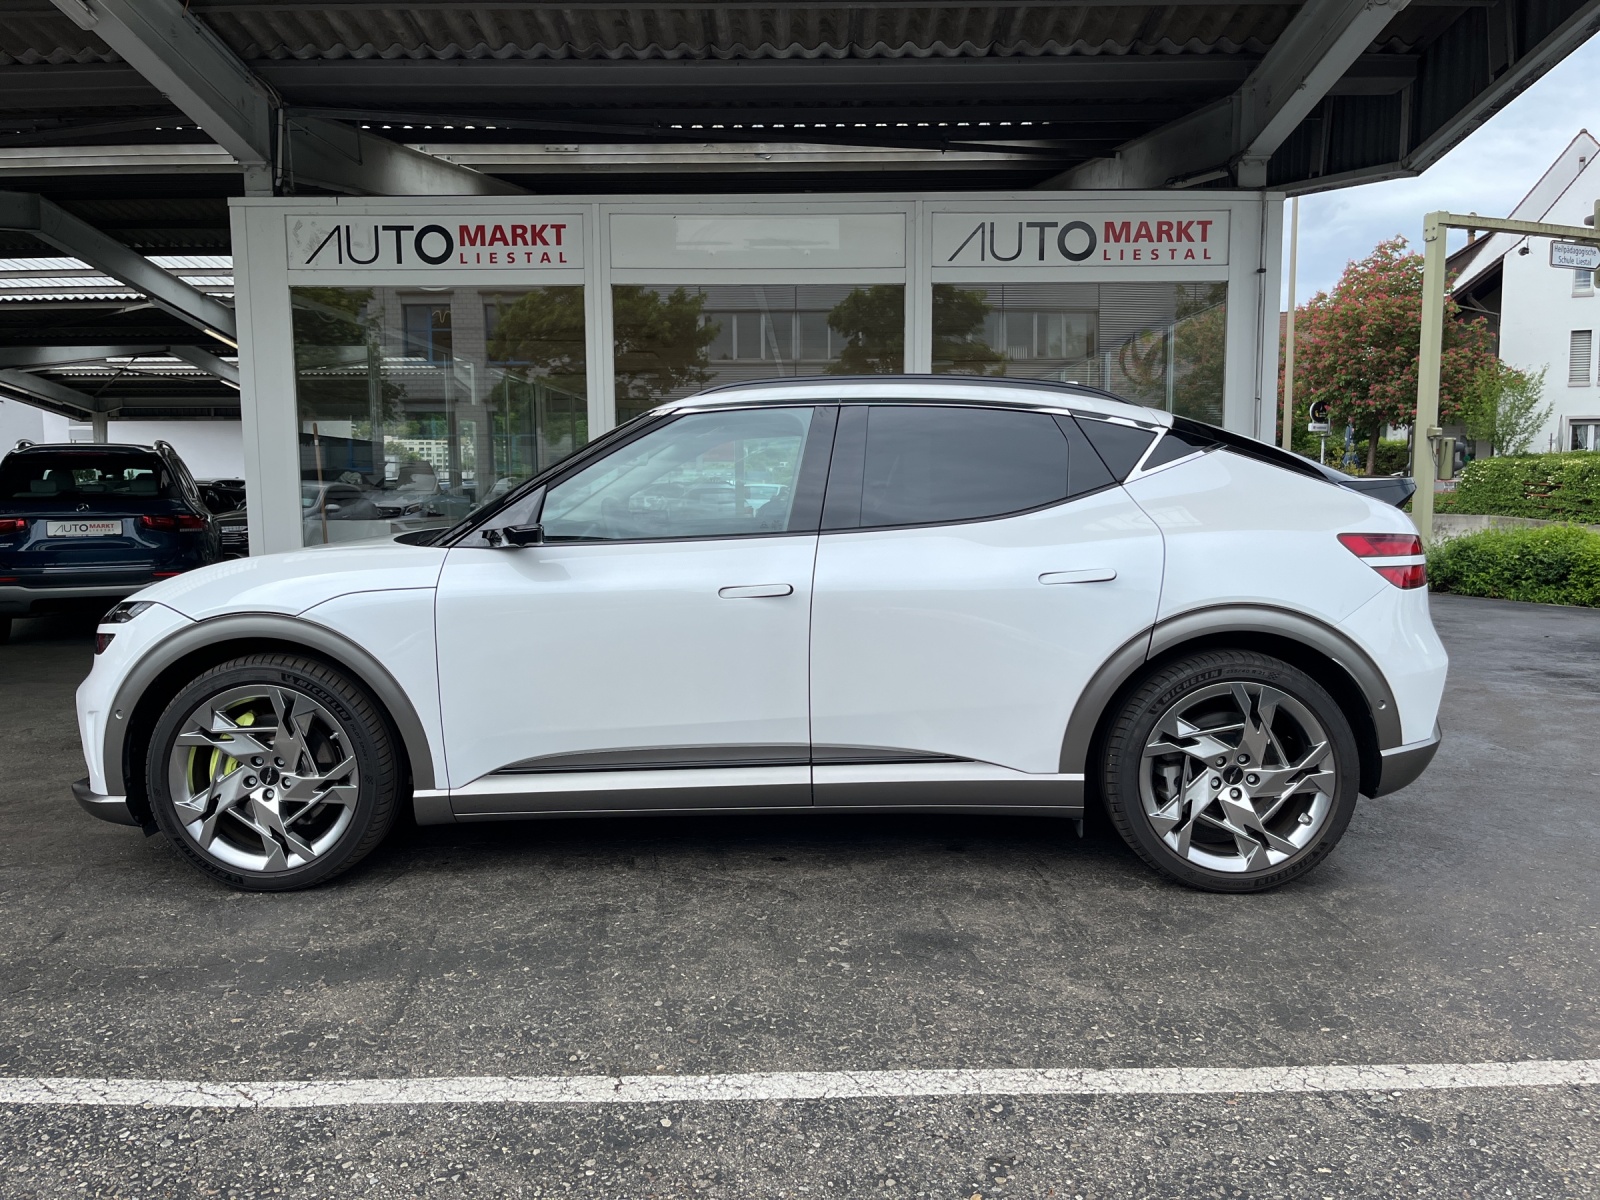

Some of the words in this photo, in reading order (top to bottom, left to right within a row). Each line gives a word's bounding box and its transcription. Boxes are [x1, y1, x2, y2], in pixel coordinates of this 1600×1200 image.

[304, 224, 454, 265] AUTO
[458, 223, 567, 247] MARKT
[947, 220, 1097, 262] AUTO
[1103, 219, 1213, 244] MARKT
[459, 251, 568, 265] LIESTAL
[1103, 248, 1212, 261] LIESTAL
[1554, 245, 1597, 257] Heilpädagogische
[1558, 256, 1575, 264] Schule
[1576, 257, 1592, 266] Liestal
[54, 523, 89, 533] AUTO
[1163, 670, 1219, 703] MICHELIN
[296, 679, 349, 721] MICHELIN
[350, 723, 362, 743] PILOT
[359, 742, 369, 761] SPORT
